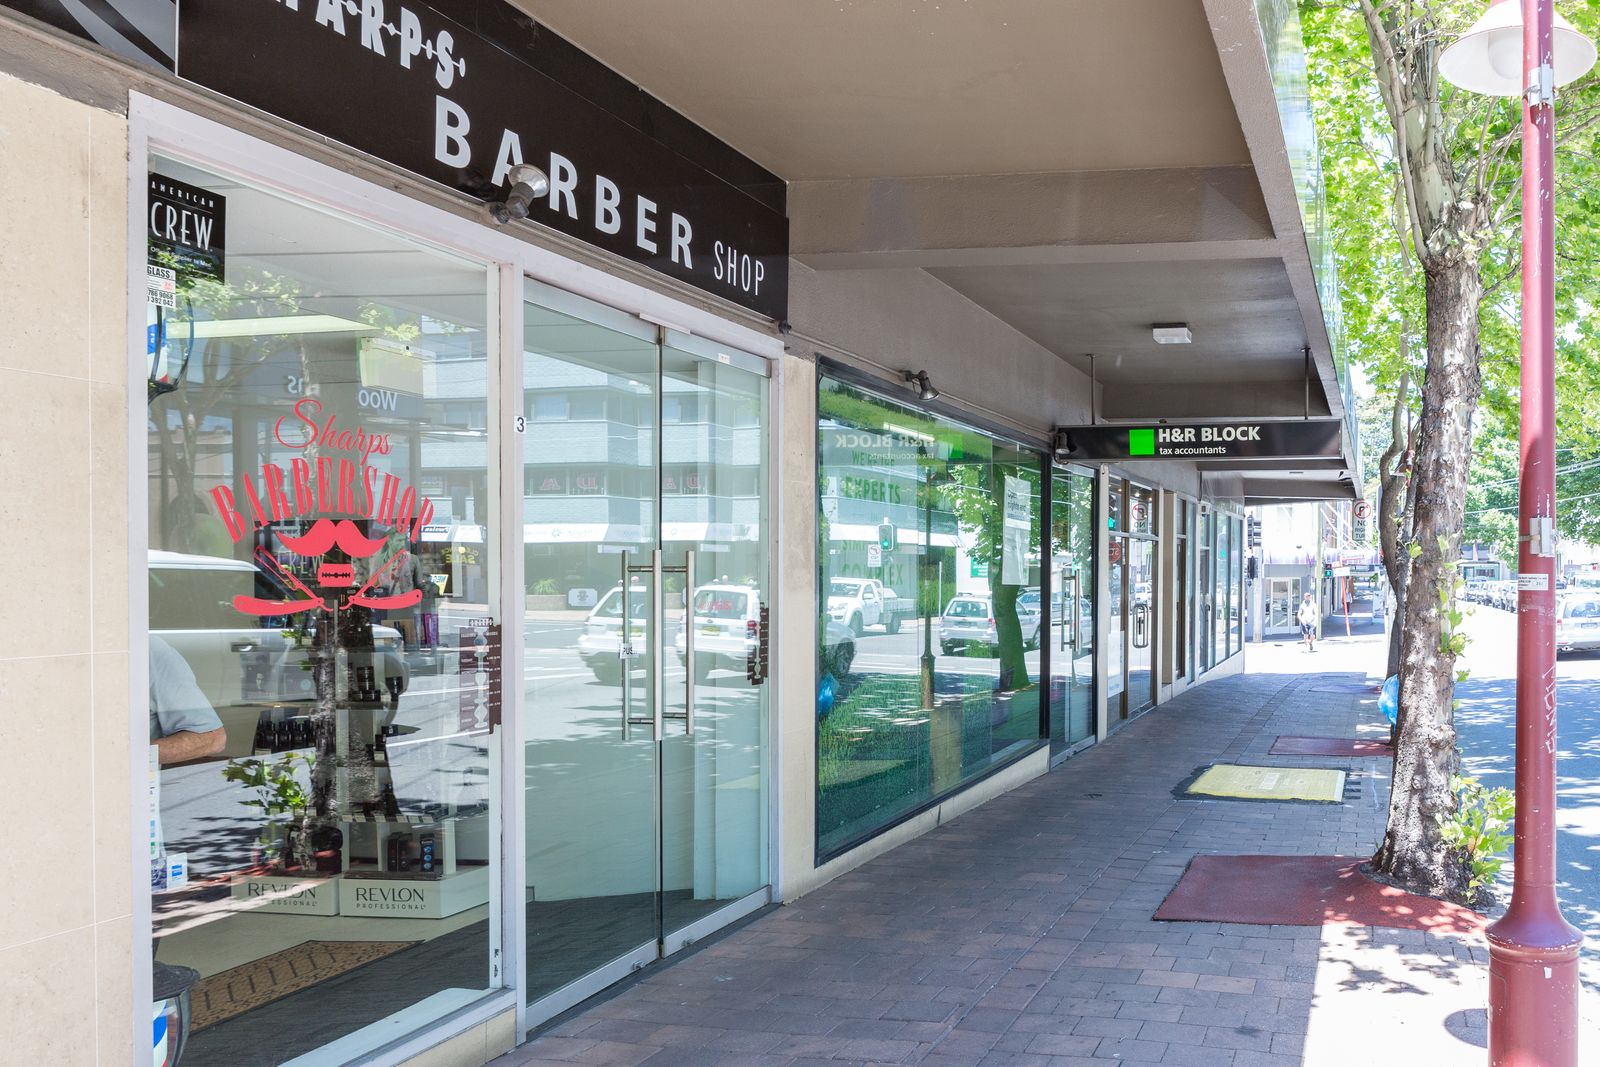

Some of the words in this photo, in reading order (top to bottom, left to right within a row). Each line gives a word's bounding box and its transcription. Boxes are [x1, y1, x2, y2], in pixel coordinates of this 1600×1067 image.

[270, 0, 456, 90] ARPS
[151, 180, 214, 208] AMERICAN
[434, 94, 694, 270] BARBER
[713, 239, 765, 296] SHOP
[150, 201, 214, 251] CREW
[146, 265, 171, 279] GLASS
[274, 398, 393, 467] Sharps
[516, 416, 525, 433] 3
[1158, 427, 1196, 443] H&R
[1200, 426, 1262, 442] BLOCK
[1159, 447, 1173, 455] tax
[1174, 446, 1226, 455] accountants
[208, 456, 435, 544] BARBERSHOP
[845, 475, 901, 505] EXPERTS
[248, 882, 316, 899] REVLON
[355, 887, 425, 902] REVLON
